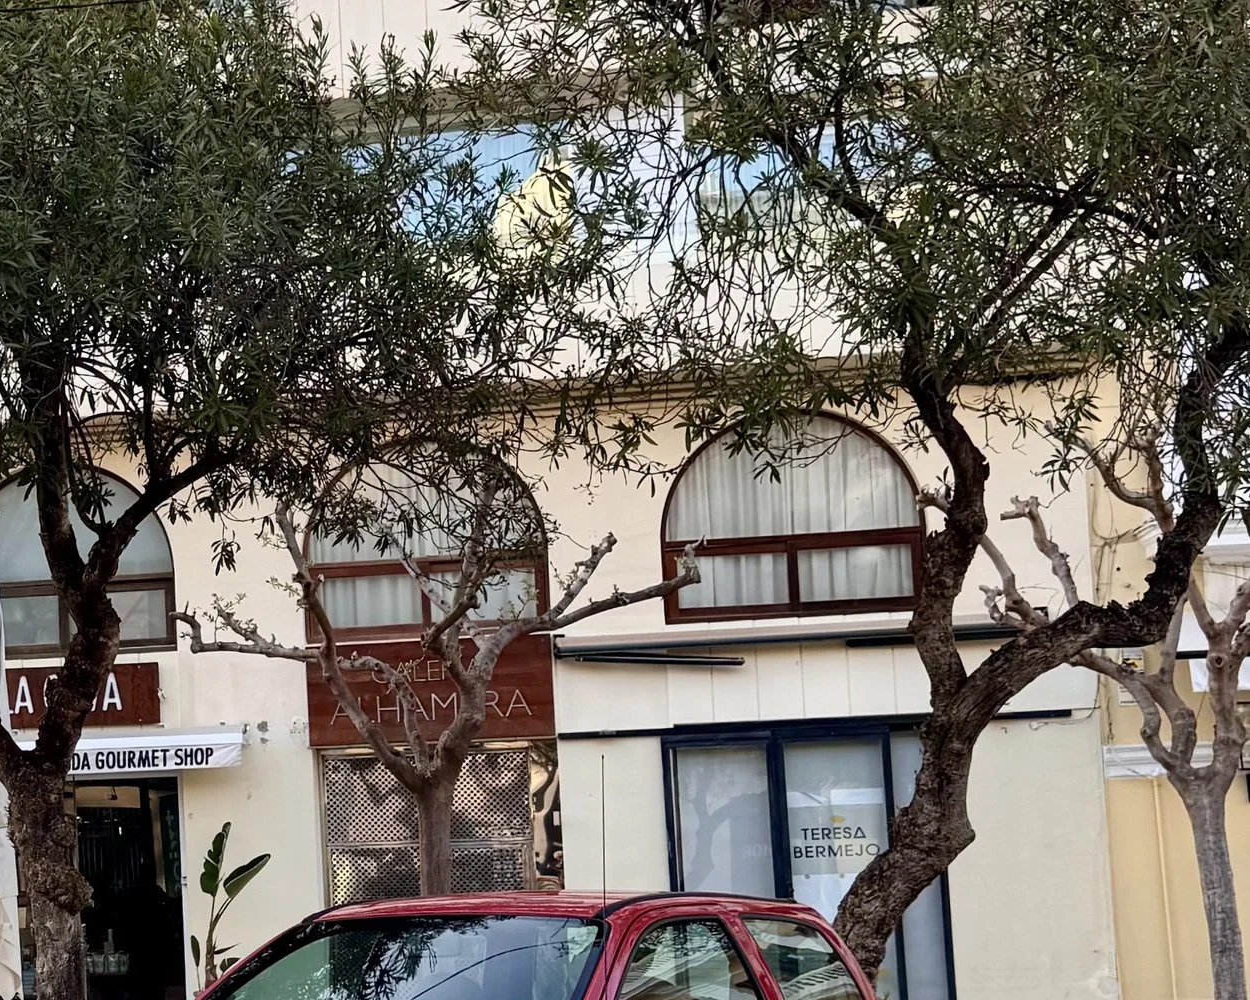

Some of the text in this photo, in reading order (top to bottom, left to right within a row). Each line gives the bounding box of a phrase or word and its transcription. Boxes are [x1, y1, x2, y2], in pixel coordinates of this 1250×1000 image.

[95, 749, 170, 770] GOURMET
[174, 747, 214, 766] SHOP
[801, 826, 867, 841] TERESA
[793, 843, 880, 859] BERMEJO
